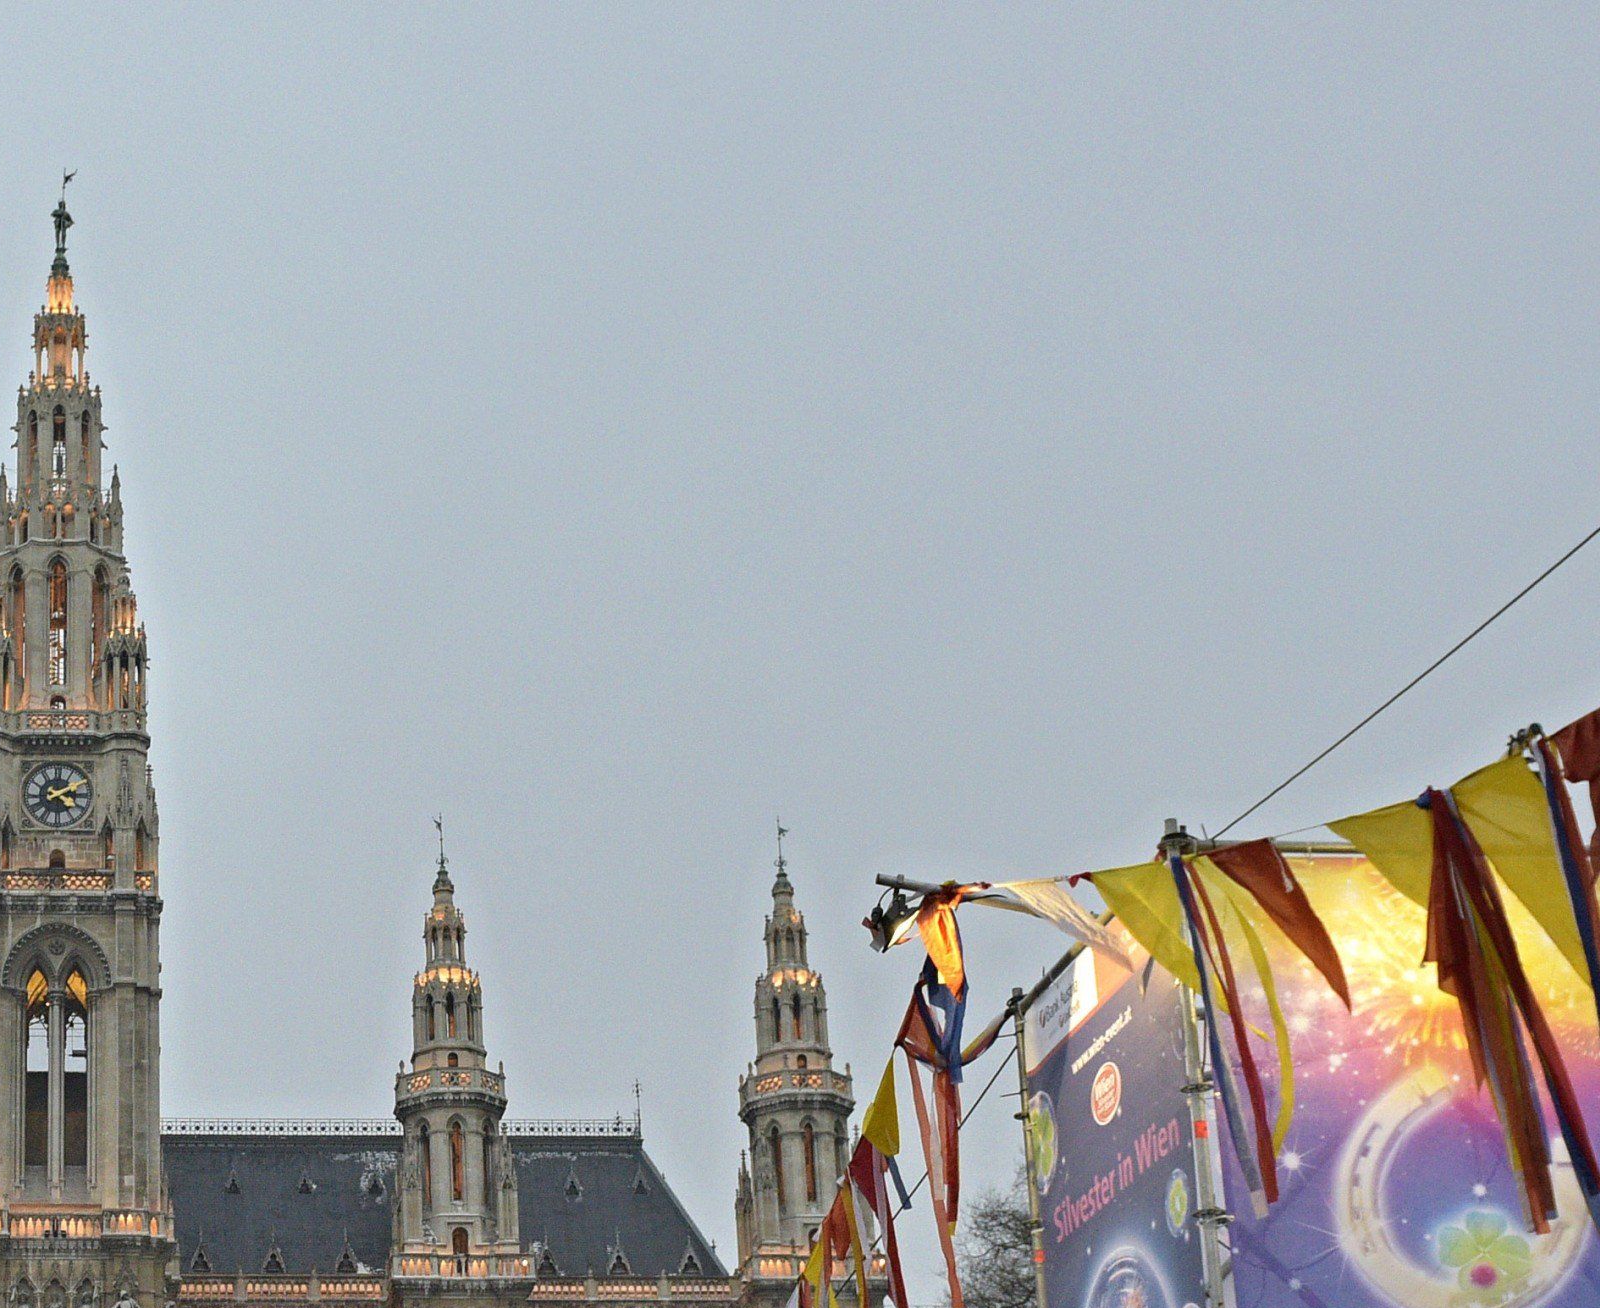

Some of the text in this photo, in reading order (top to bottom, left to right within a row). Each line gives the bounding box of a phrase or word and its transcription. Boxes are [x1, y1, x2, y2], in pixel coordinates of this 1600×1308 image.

[1053, 1118, 1181, 1243] Silvester in Wien
